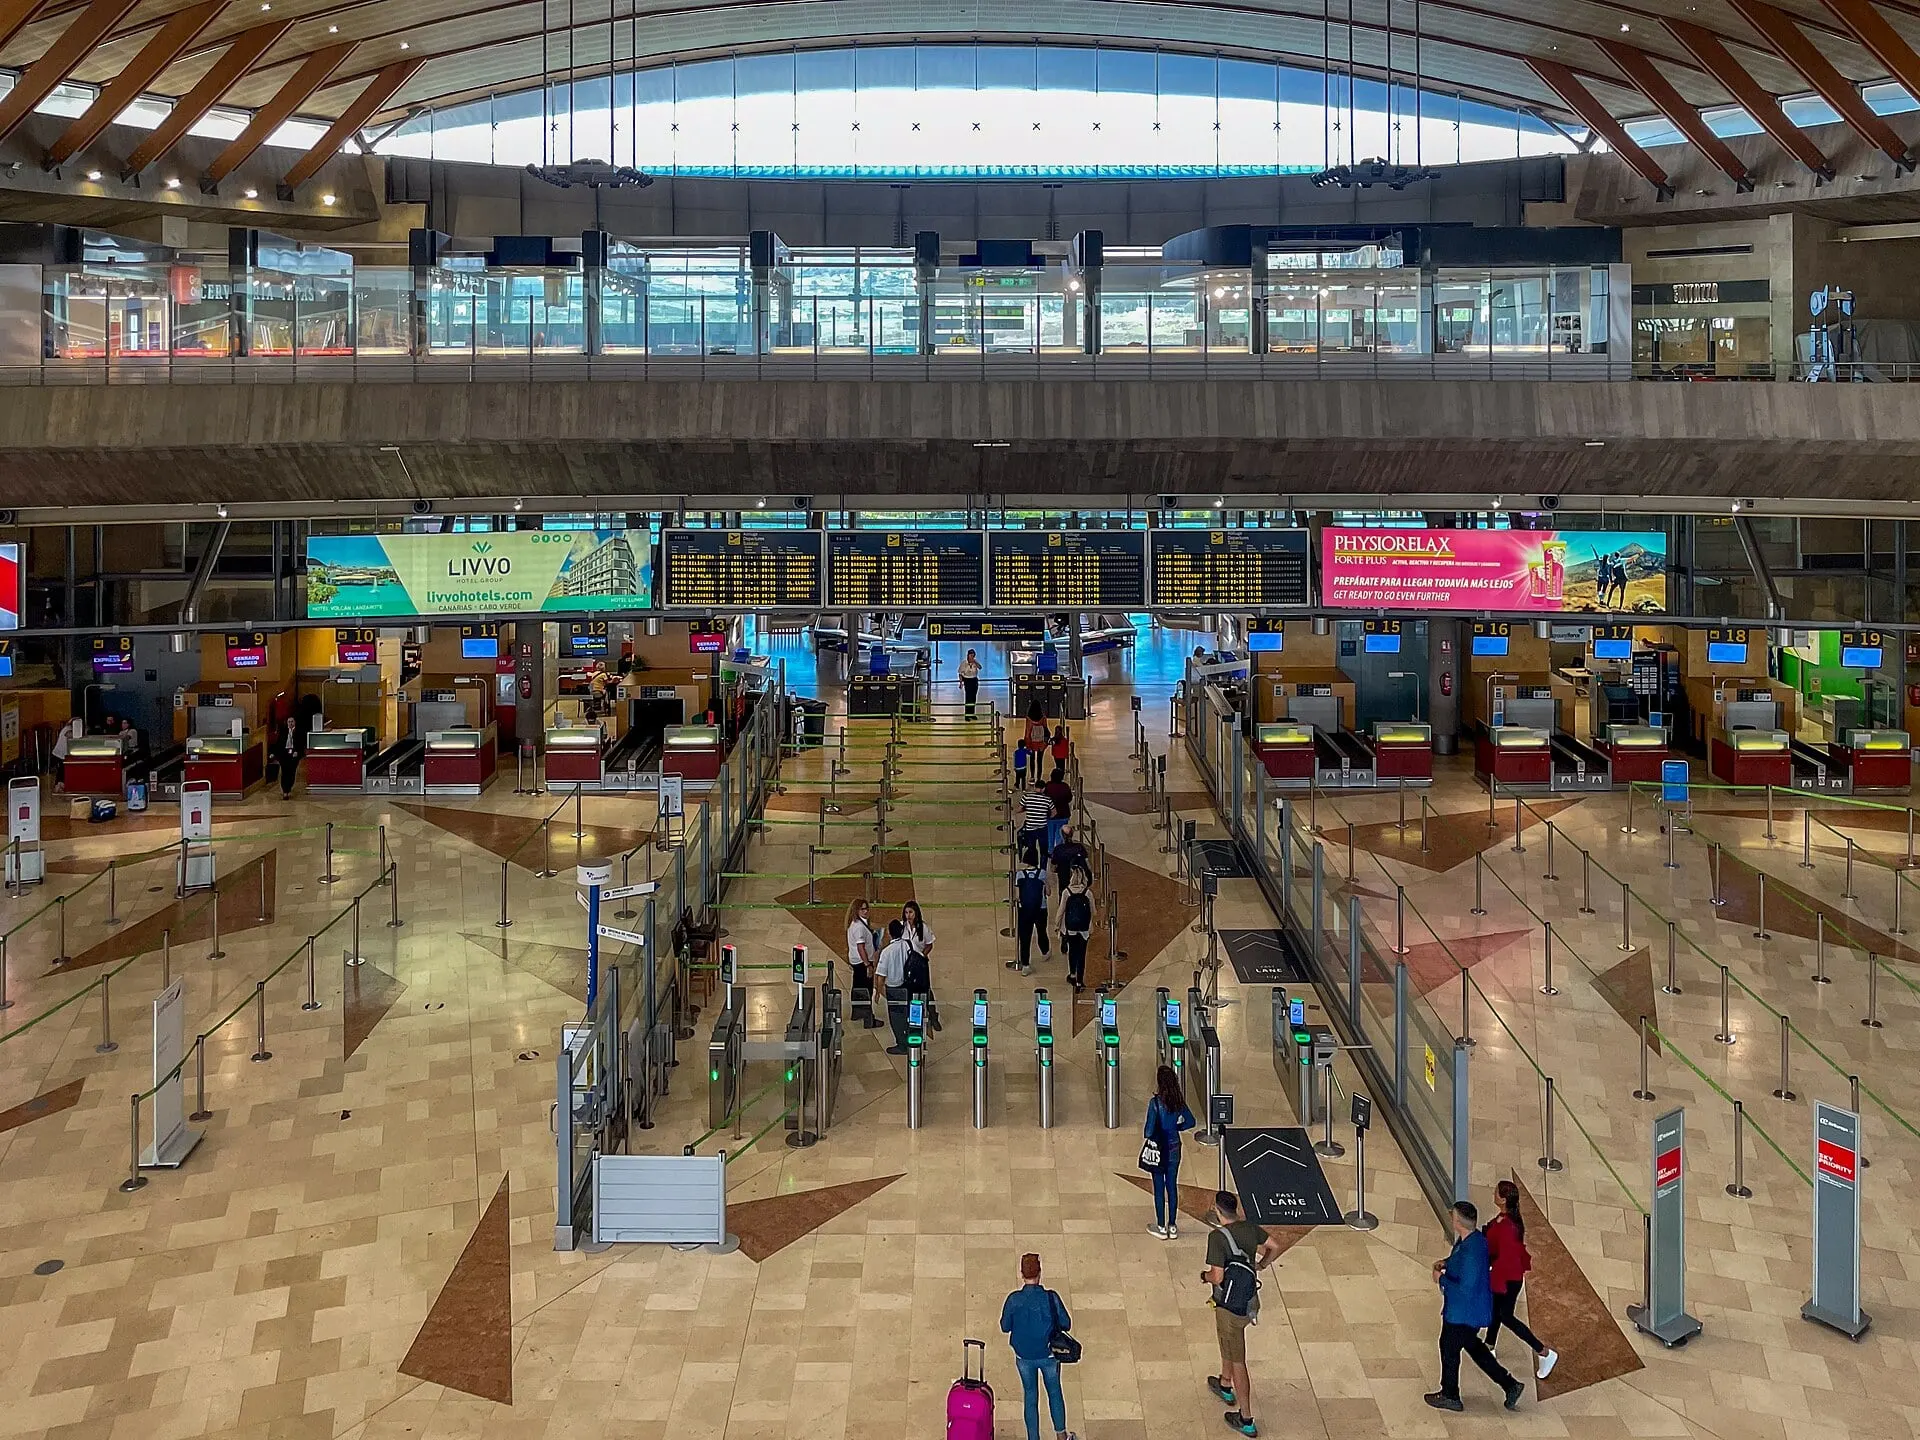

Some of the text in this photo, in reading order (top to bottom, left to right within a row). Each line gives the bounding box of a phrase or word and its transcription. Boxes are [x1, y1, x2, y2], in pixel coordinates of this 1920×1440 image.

[1334, 536, 1450, 557] PHYSIORELAX
[1334, 556, 1387, 565] FORTE PLUS
[449, 558, 510, 576] LIVVO
[1334, 575, 1513, 588] PREPÁRATE PARA LLEGAR TODAVÍA MÁS LEJOS
[427, 590, 532, 602] livvohotels.com
[1334, 590, 1450, 601] GET READY TO GO EVEN FURTHER
[481, 624, 498, 636] 11
[588, 622, 606, 635] 12
[708, 620, 725, 631] 13
[1266, 619, 1283, 631] 14
[1382, 620, 1400, 632] 15
[1490, 623, 1507, 634] 16
[254, 632, 264, 645] 9
[355, 630, 374, 642] 10
[1611, 626, 1630, 639] 17
[1726, 629, 1746, 642] 18
[121, 637, 130, 650] 8
[1861, 632, 1881, 646] 19
[1819, 1152, 1833, 1162] SKY
[1819, 1158, 1852, 1175] PRIORITY
